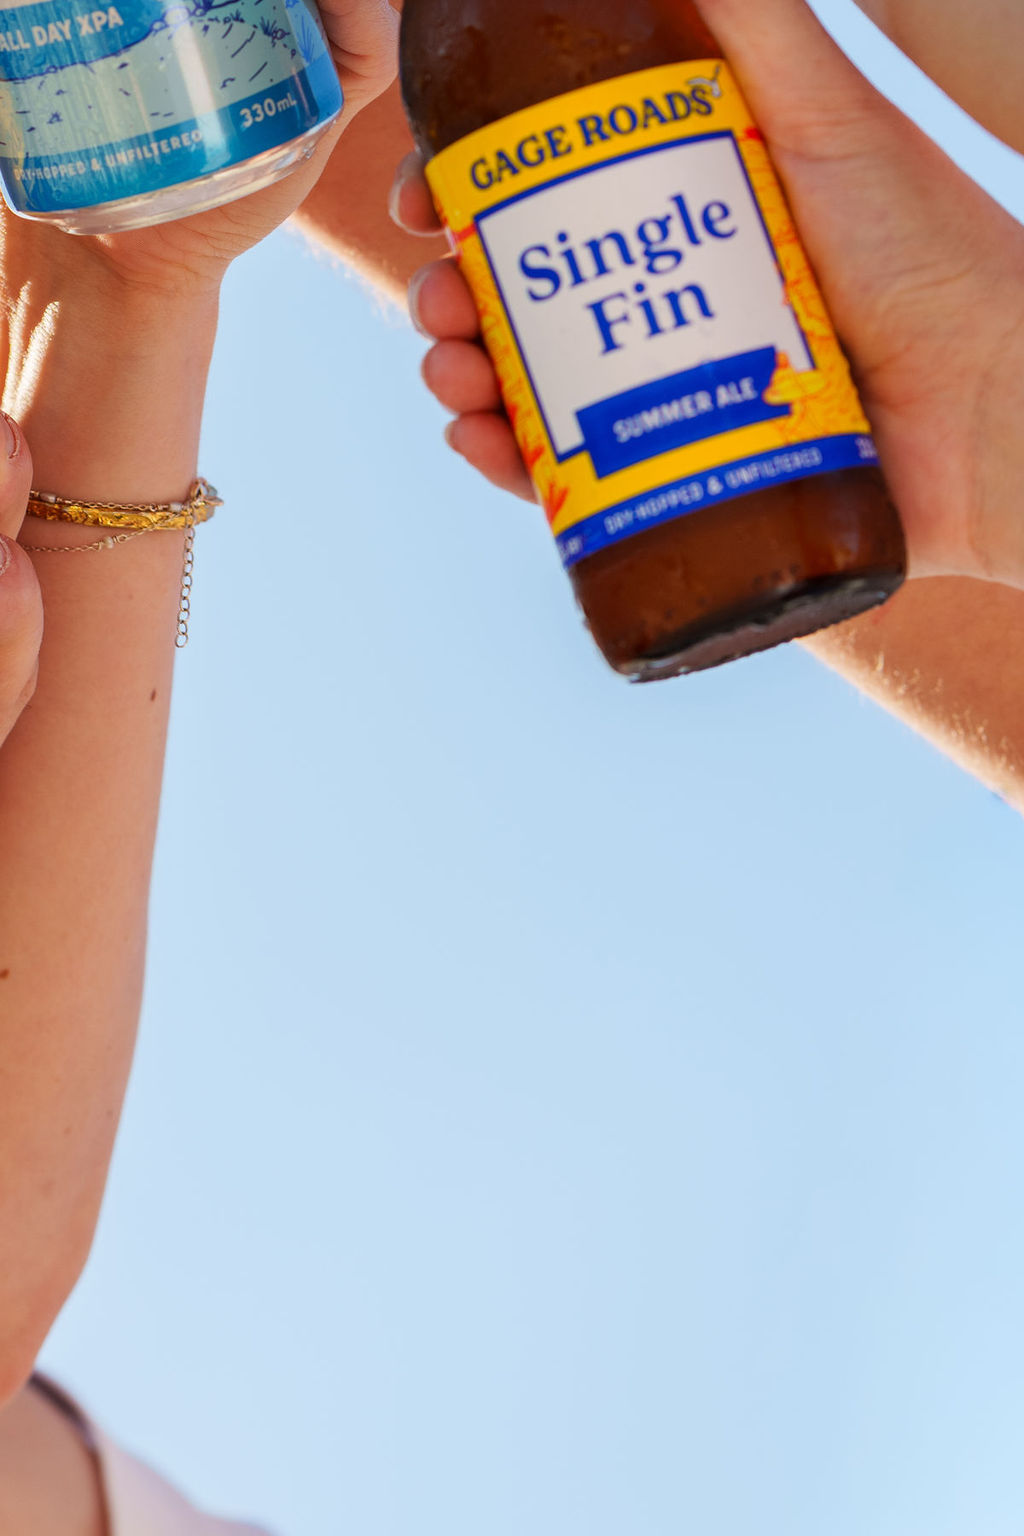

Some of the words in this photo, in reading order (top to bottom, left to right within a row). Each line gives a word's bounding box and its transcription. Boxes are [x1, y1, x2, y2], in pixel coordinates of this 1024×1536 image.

[32, 19, 74, 46] DAY
[76, 6, 123, 37] XPA
[239, 93, 297, 128] 330mL
[470, 125, 573, 190] GAGE
[577, 85, 714, 147] ROADS
[105, 131, 203, 168] UNFILTERED
[518, 192, 738, 302] Single
[585, 282, 716, 355] Fin
[612, 390, 714, 443] SUMMER
[716, 376, 758, 409] ALE
